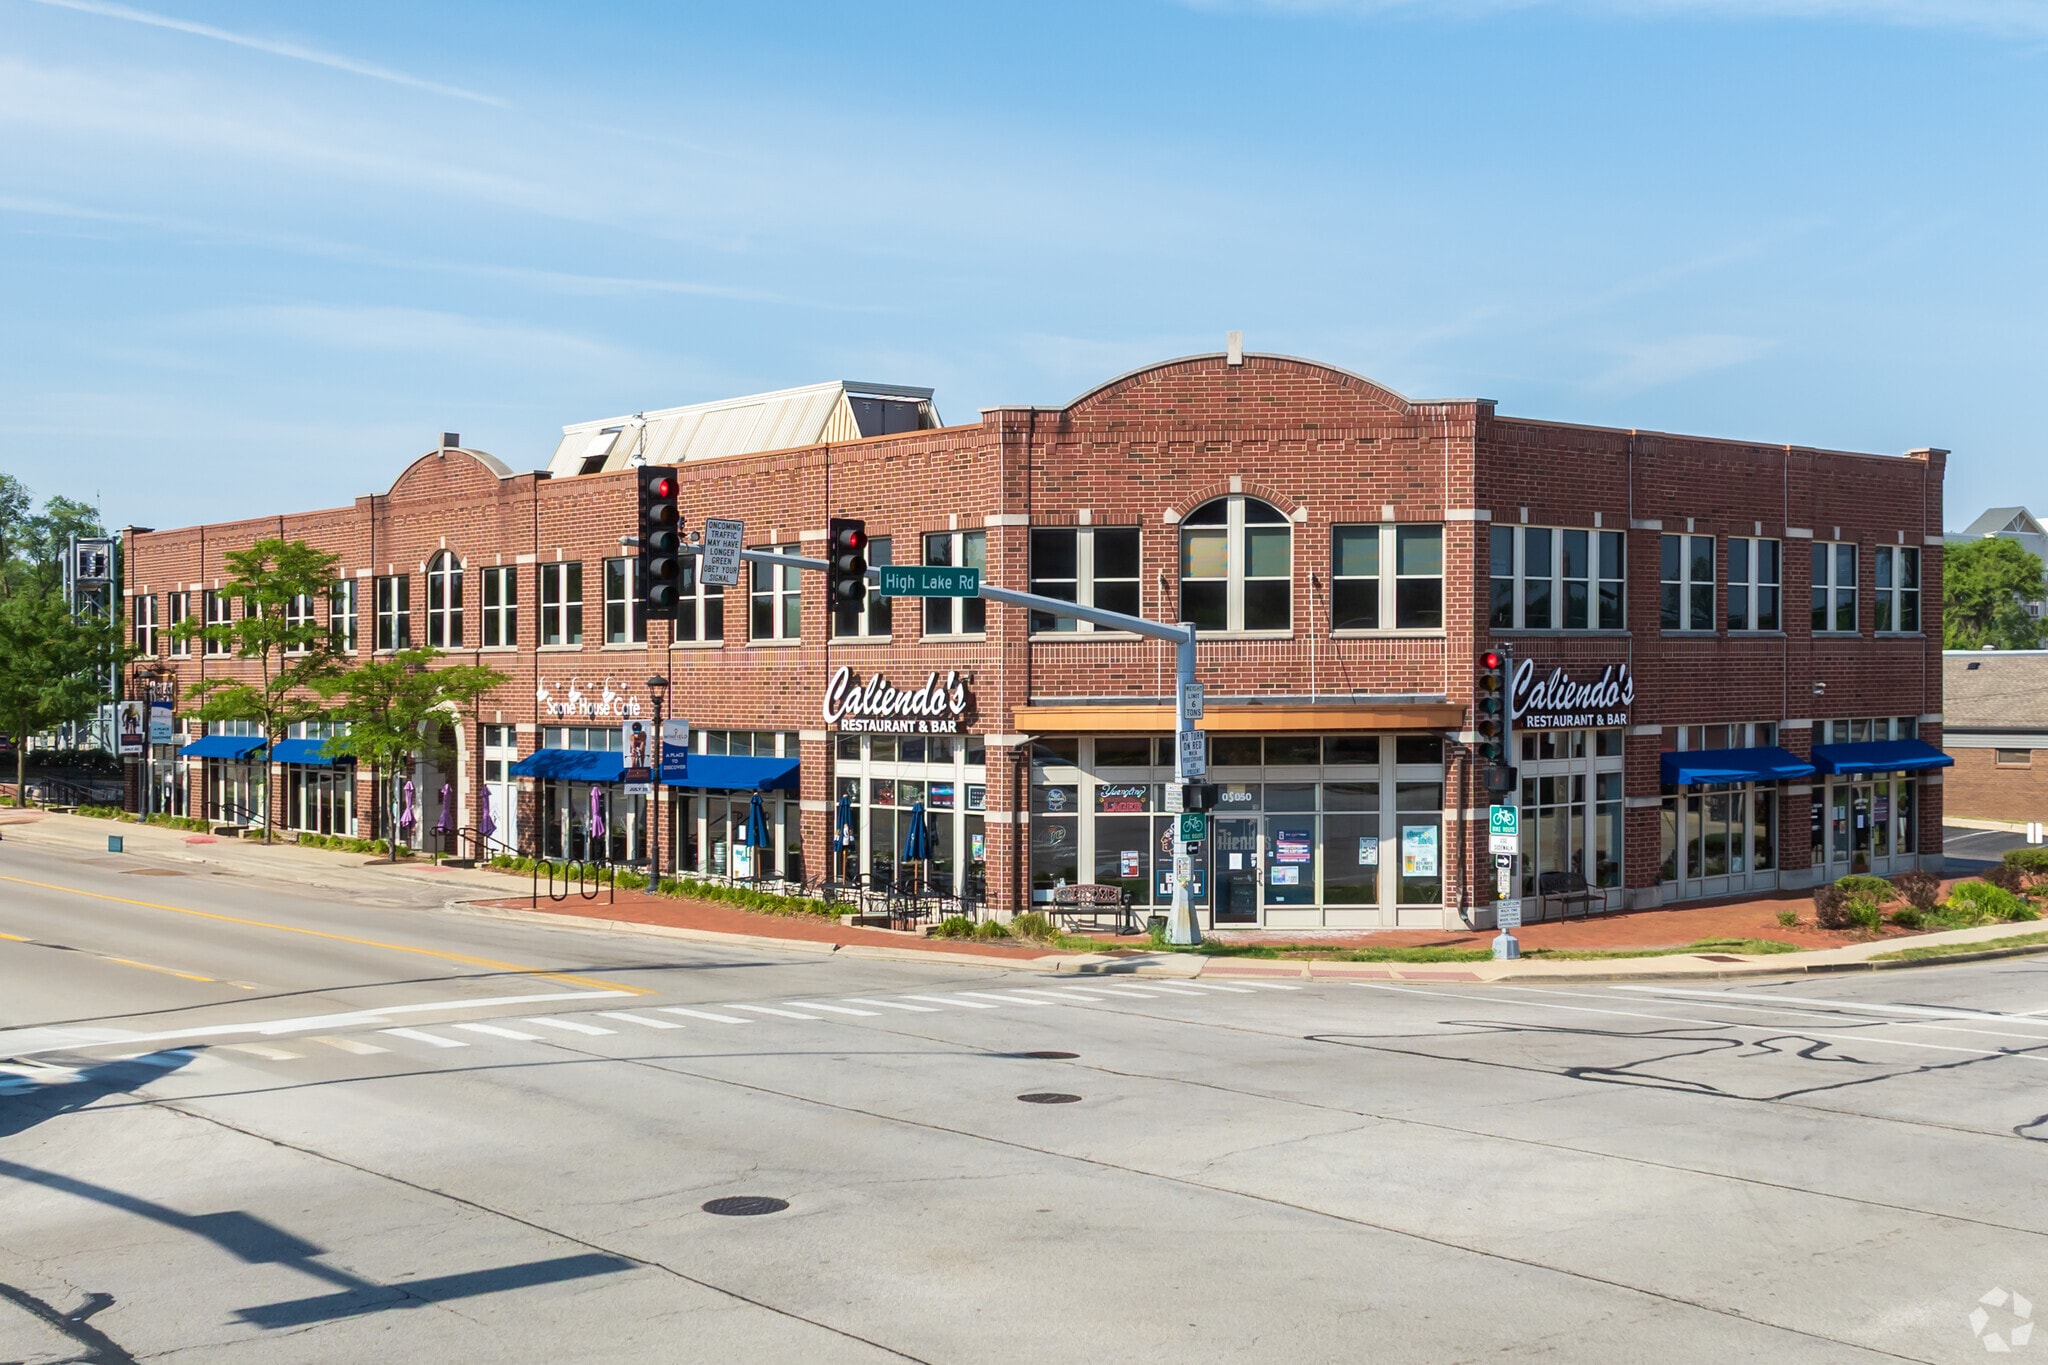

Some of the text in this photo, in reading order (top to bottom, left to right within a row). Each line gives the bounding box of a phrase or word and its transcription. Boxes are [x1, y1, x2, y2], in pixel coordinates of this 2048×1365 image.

[709, 522, 741, 531] ONCOMING
[712, 531, 737, 539] TRAFFIC
[710, 548, 735, 556] LONGER
[712, 557, 732, 565] GREEN
[704, 565, 719, 573] OBEY
[709, 574, 729, 582] SIGNAL
[886, 574, 974, 594] High Lake Rd
[1512, 658, 1635, 720] Caliendo's
[823, 666, 966, 723] Caliendo's
[547, 697, 576, 715] Scone
[580, 697, 610, 715] House
[1527, 713, 1627, 727] RESTAURANT & BAR
[841, 720, 957, 733] RESTAURANT & BAR
[1182, 732, 1203, 742] NO TURN
[1184, 741, 1202, 750] ON RED
[1100, 784, 1146, 798] Yuengling
[1104, 801, 1143, 812] LAGER
